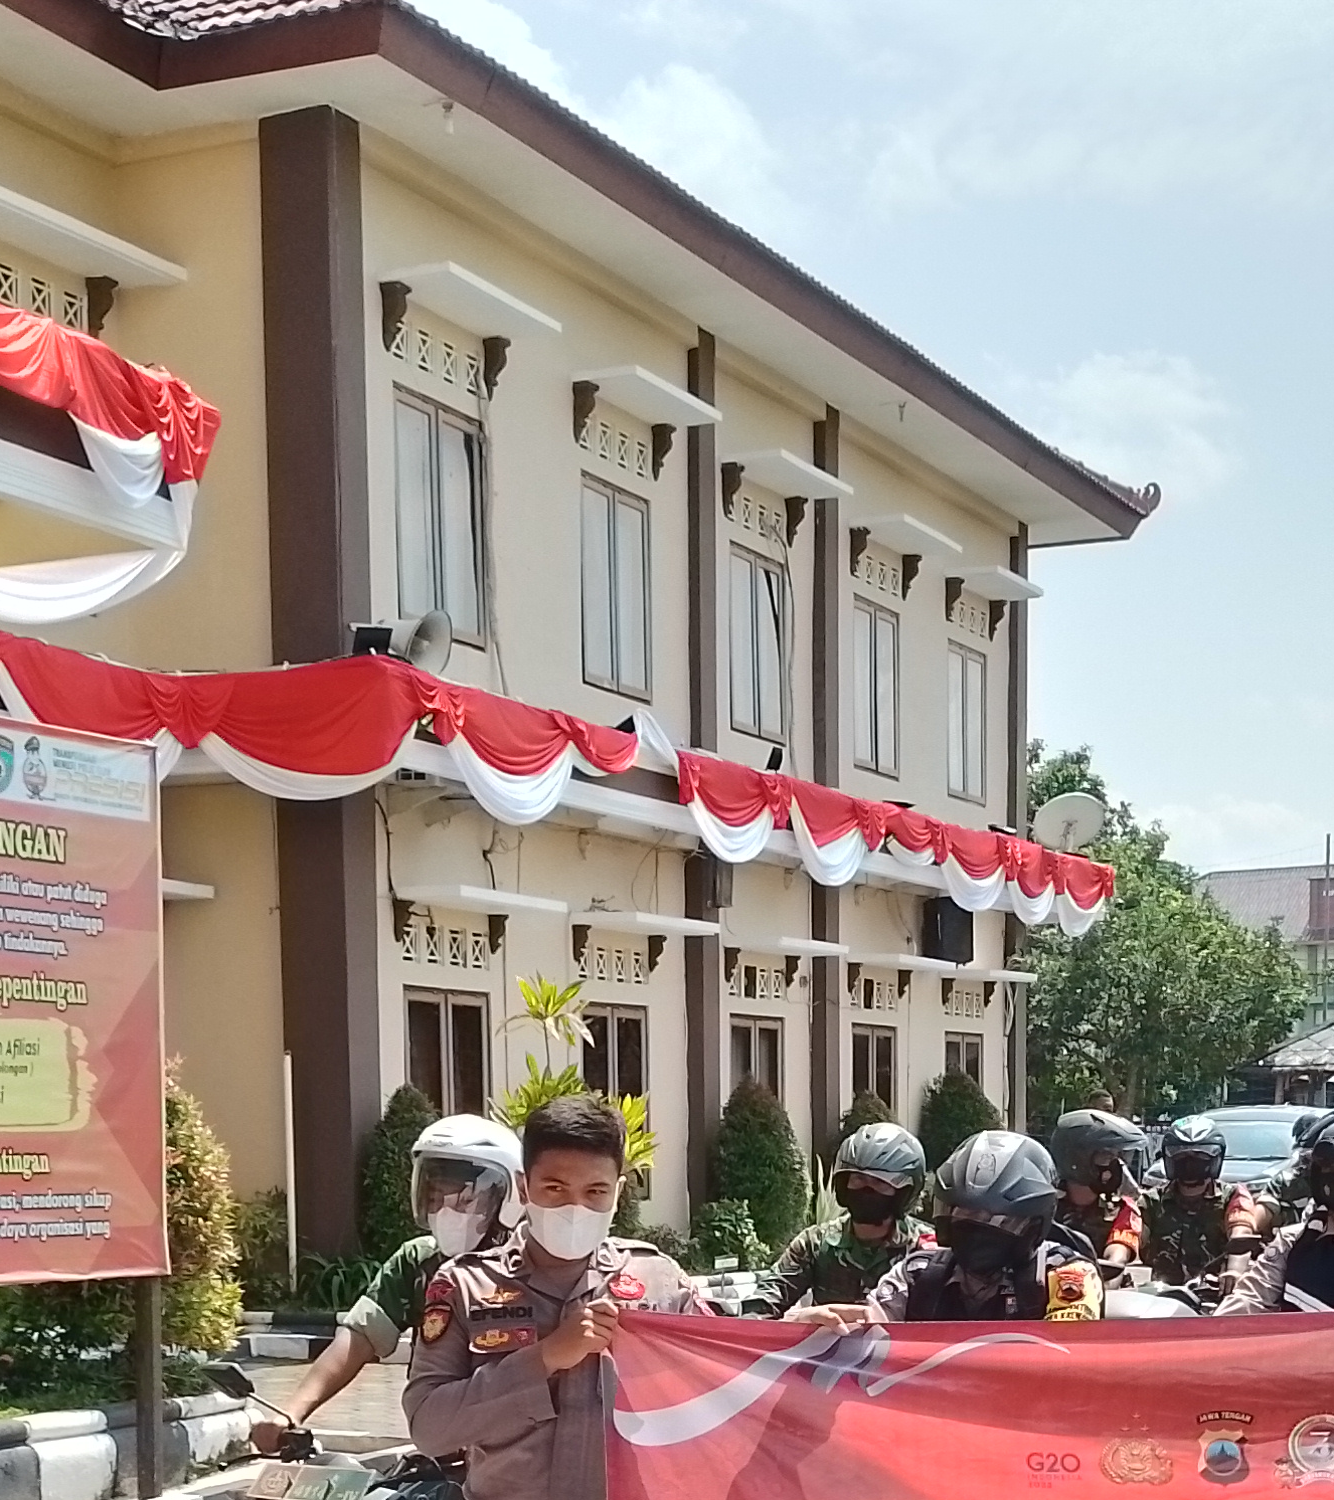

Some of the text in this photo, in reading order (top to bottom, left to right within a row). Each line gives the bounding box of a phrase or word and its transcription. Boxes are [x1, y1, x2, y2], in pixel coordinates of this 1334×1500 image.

[21, 875, 45, 898] atau
[46, 879, 73, 904] patut
[74, 881, 109, 910] diduga
[5, 905, 59, 932] wewenang
[60, 908, 104, 936] sehingga
[5, 1037, 40, 1060] Afiliasi
[21, 1188, 82, 1213] mendorong
[83, 1186, 113, 1212] sikap
[29, 1216, 83, 1242] organisasi
[84, 1219, 111, 1240] yang
[470, 1307, 533, 1322] EFENDI
[1199, 1413, 1219, 1423] JAWA
[1026, 1452, 1081, 1473] G20
